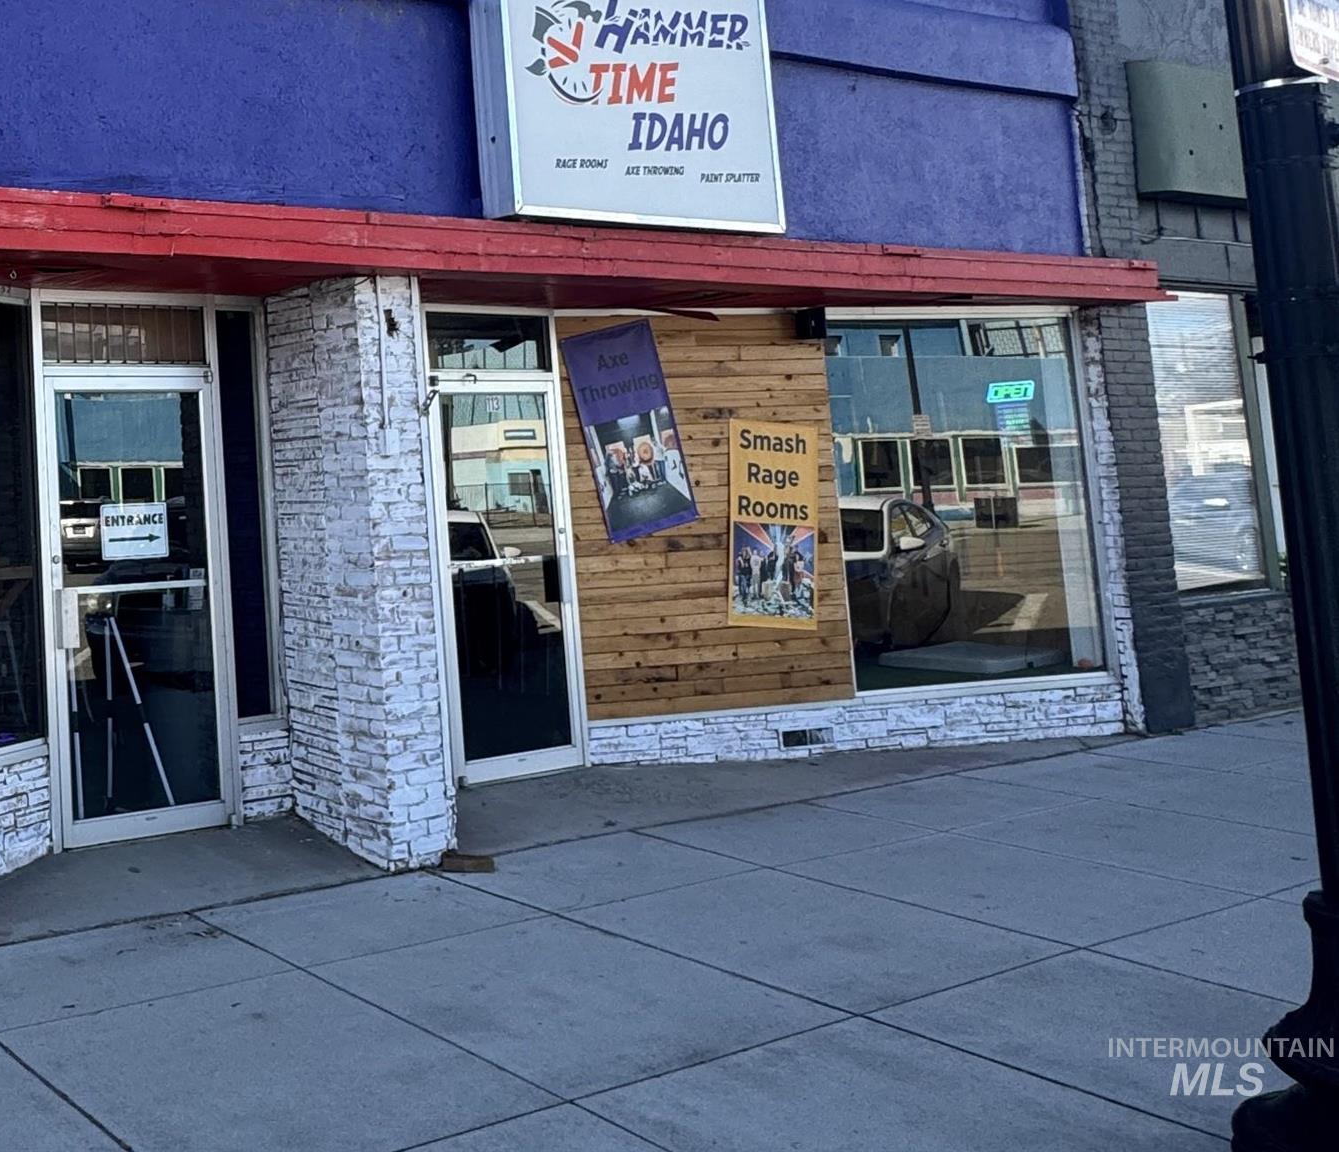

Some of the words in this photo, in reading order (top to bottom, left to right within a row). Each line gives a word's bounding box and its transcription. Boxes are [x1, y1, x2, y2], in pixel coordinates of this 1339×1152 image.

[594, 0, 750, 53] HAMMER
[589, 62, 679, 105] TIME
[627, 112, 729, 151] IDAHO
[555, 158, 577, 169] RAGE
[579, 158, 608, 169] ROOMS
[625, 166, 641, 176] AXE
[643, 165, 684, 176] THROWING
[700, 173, 723, 183] PAINT
[725, 173, 760, 183] SPLATTER
[598, 352, 630, 372] Axe
[578, 374, 660, 404] Throwing
[990, 384, 1031, 399] OPEN
[739, 429, 806, 454] Smash
[747, 462, 799, 489] Rage
[104, 513, 164, 527] ENTRANCE
[738, 495, 808, 521] Rooms
